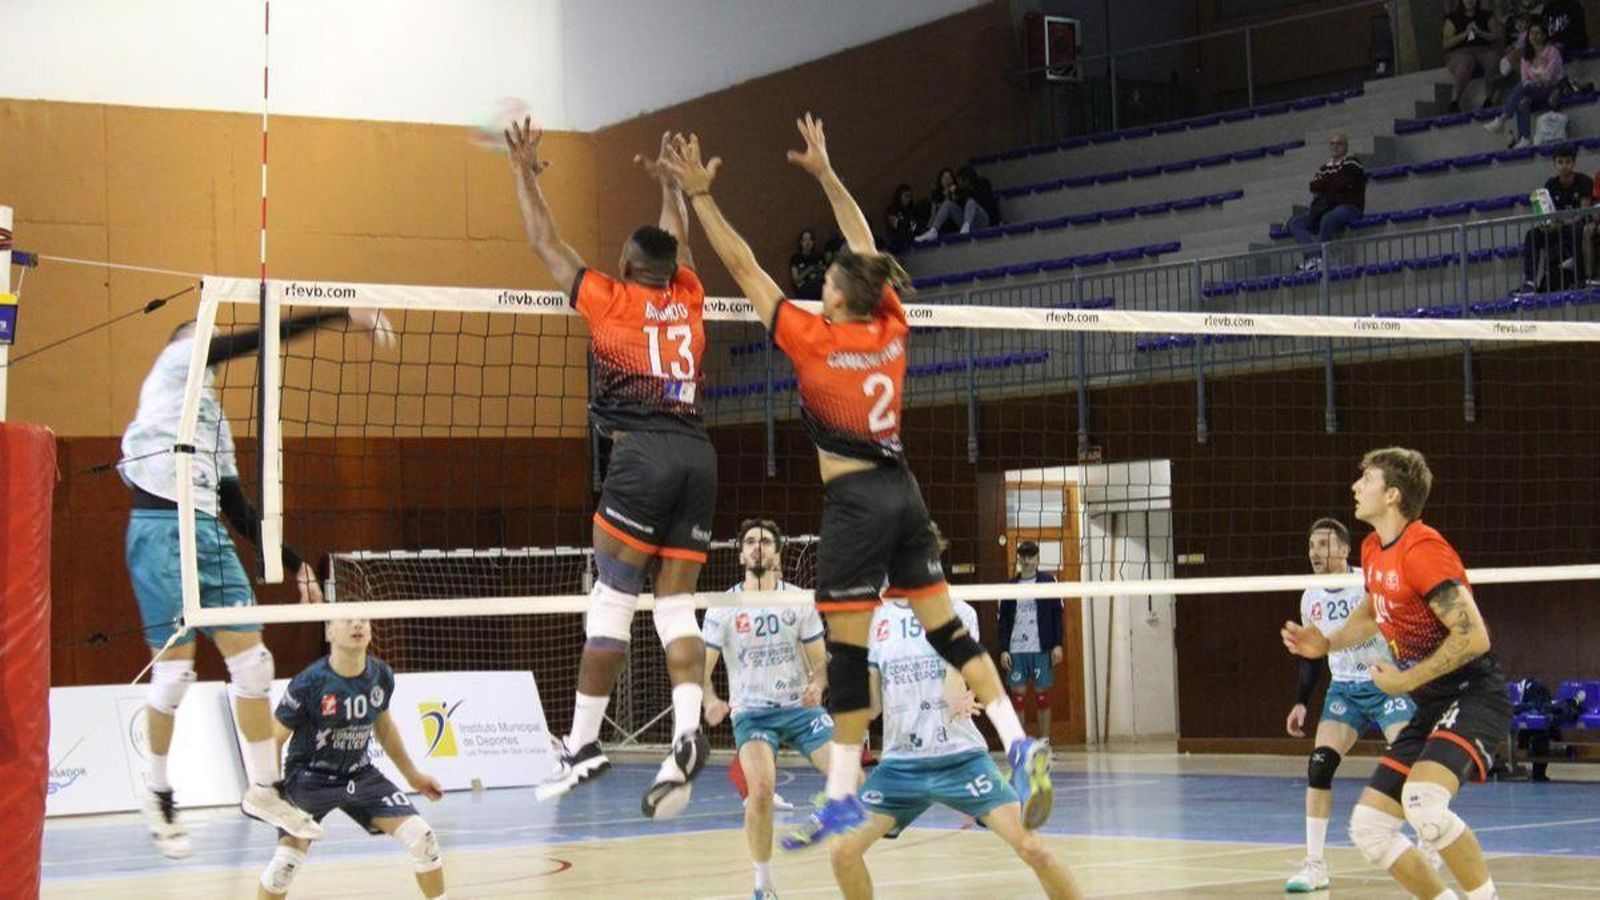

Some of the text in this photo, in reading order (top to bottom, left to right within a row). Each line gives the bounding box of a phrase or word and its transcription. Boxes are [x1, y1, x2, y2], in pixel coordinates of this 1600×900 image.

[285, 284, 356, 299] rfevb.com
[498, 290, 563, 307] rfevb.com
[704, 300, 754, 313] evb.com
[1045, 311, 1100, 323] rfevb.com
[1204, 316, 1254, 328] rfevb.com
[643, 324, 695, 381] 13
[862, 371, 897, 433] 2
[1326, 599, 1350, 621] 23
[754, 613, 780, 637] 20
[900, 616, 922, 639] 15
[343, 693, 368, 720] 10
[1383, 696, 1408, 715] 23
[810, 712, 834, 735] 20
[964, 773, 994, 799] 15
[380, 790, 411, 807] 10
